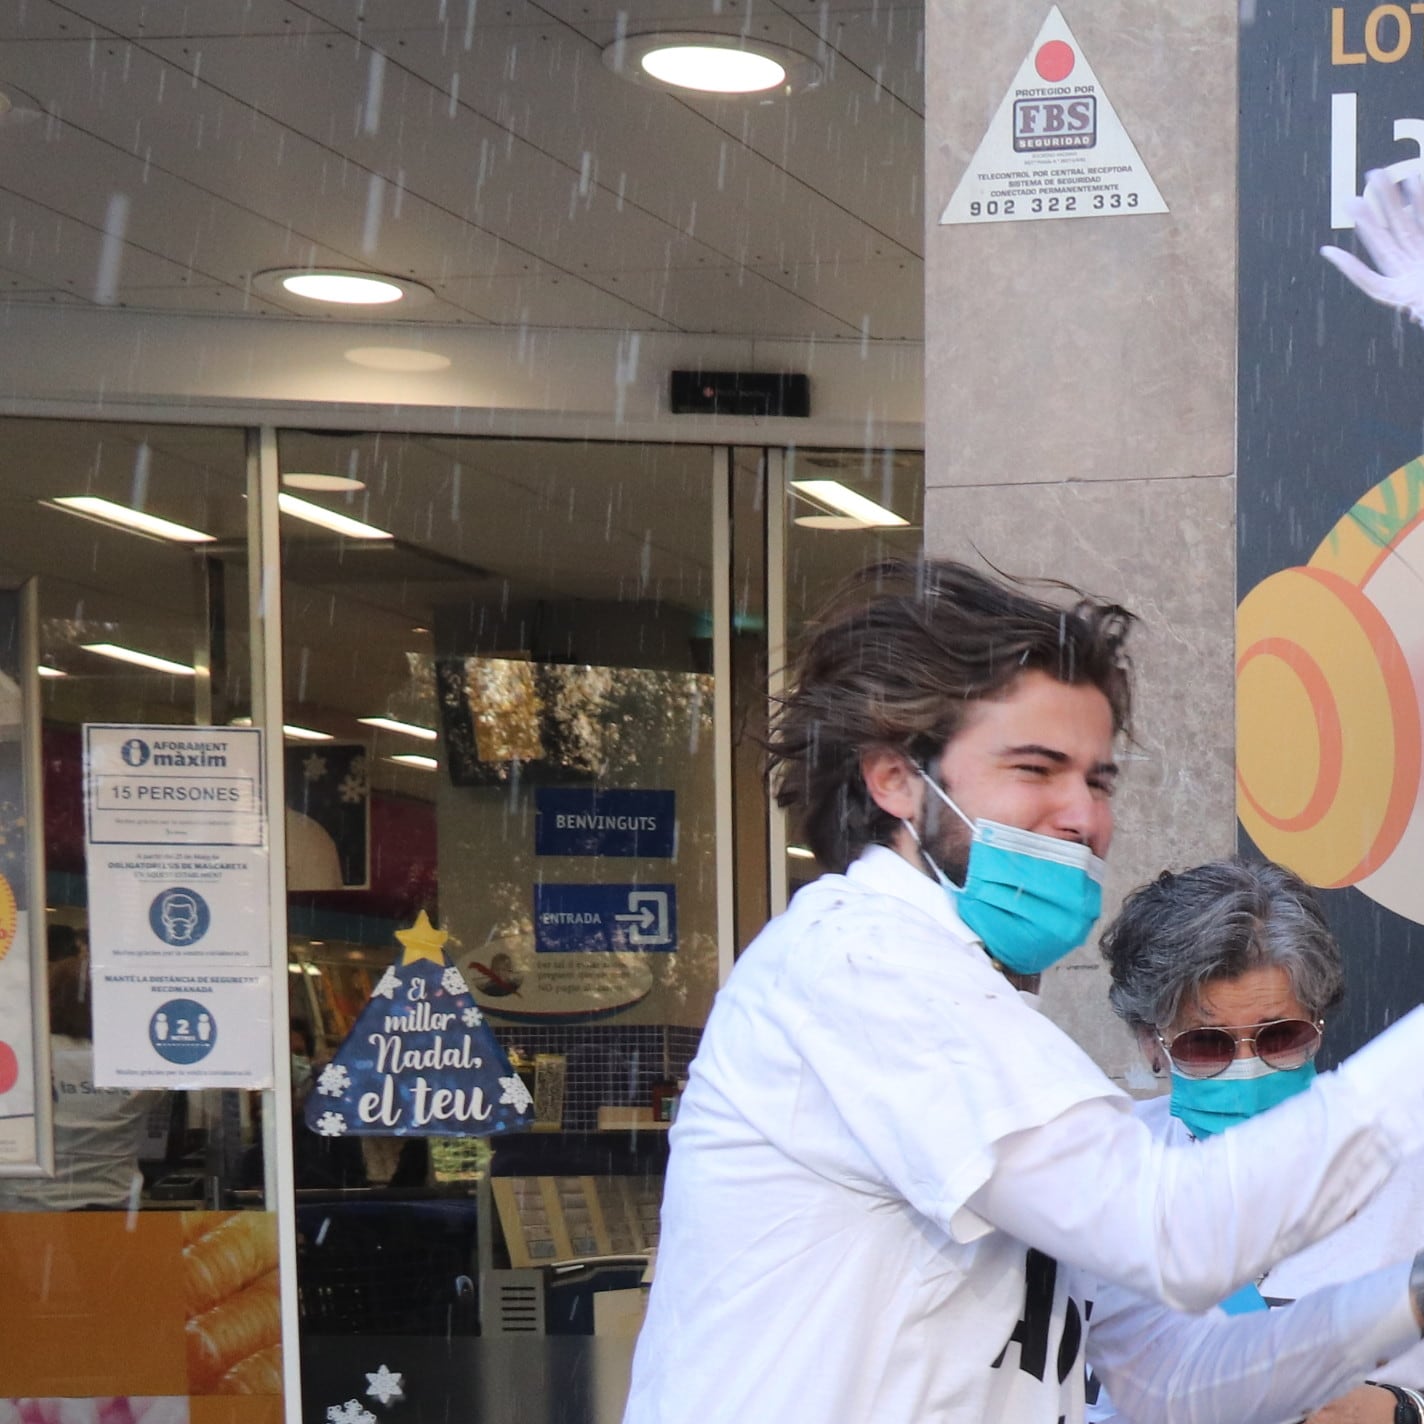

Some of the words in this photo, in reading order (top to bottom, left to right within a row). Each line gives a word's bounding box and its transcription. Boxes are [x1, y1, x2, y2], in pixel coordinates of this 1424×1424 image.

[1015, 86, 1071, 97] PROTEGIDO
[1074, 85, 1095, 94] POR
[1019, 101, 1090, 134] FBS
[1019, 137, 1091, 148] SEGURIDAD
[977, 170, 1030, 181] TELECONTROL
[1033, 169, 1049, 177] POR
[1051, 167, 1085, 176] CENTRAL
[1087, 165, 1133, 174] RECEPTORA
[1008, 178, 1042, 188] SISTEMA
[1057, 176, 1101, 185] SEGURIDAD
[990, 188, 1037, 198] CONECTADO
[1038, 183, 1120, 195] PERMANENTEMENTE
[970, 200, 1016, 217] 902
[1031, 196, 1077, 213] 322
[1093, 192, 1139, 209] 333
[153, 741, 229, 752] AFORAMENT
[153, 751, 227, 767] màxim
[112, 786, 131, 799] 15
[138, 786, 240, 801] PERSONES
[556, 814, 657, 831] BENVINGUTS
[542, 912, 602, 925] ENTRADA
[407, 977, 428, 1001] El
[384, 1002, 457, 1033] millor
[175, 1018, 190, 1035] 2
[368, 1033, 482, 1074] Nadal,
[358, 1074, 402, 1126] el
[409, 1077, 492, 1125] teu
